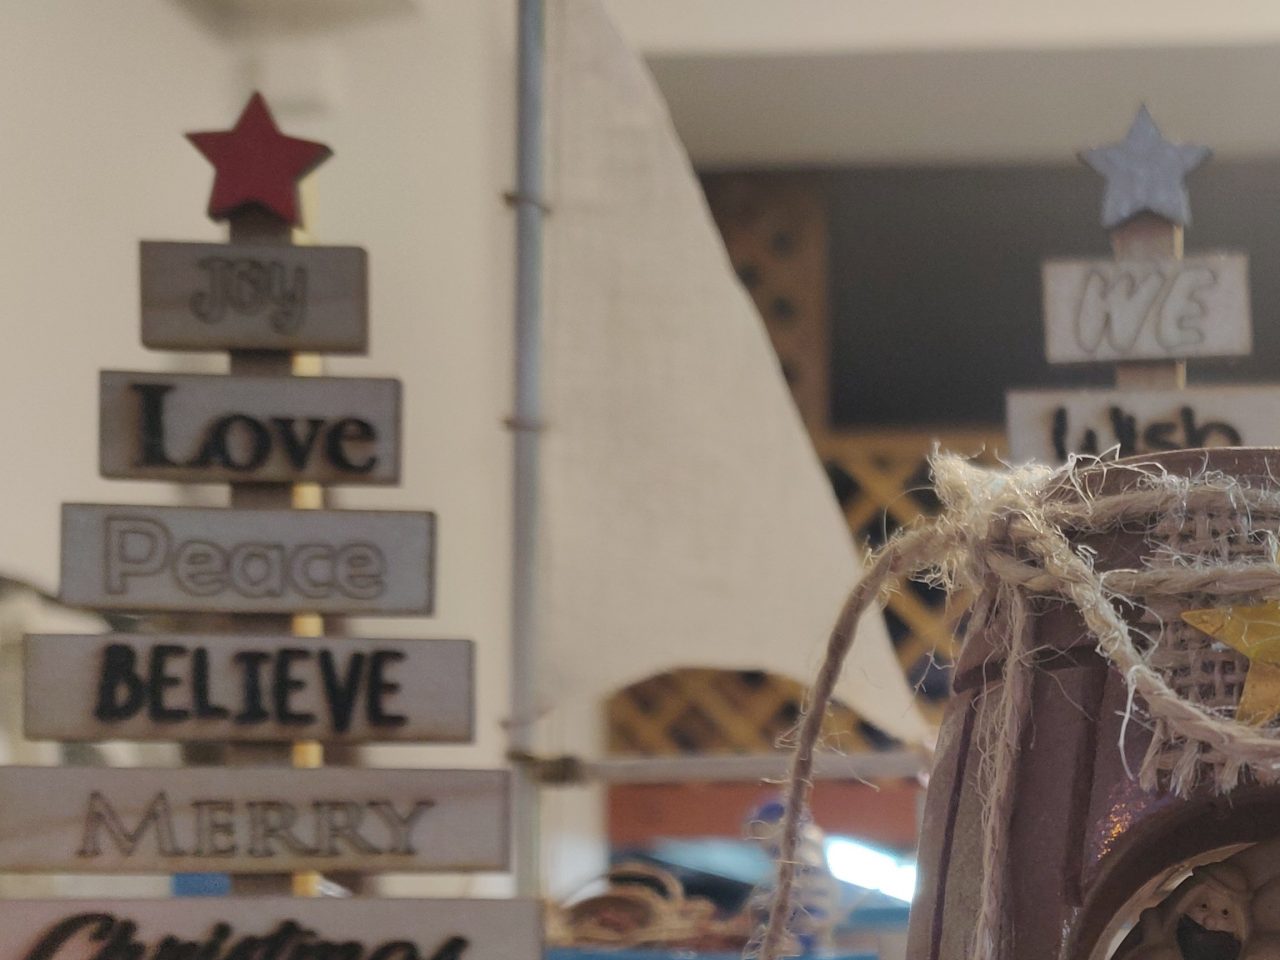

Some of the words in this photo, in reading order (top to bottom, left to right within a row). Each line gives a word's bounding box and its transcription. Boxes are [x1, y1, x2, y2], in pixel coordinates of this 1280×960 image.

[128, 383, 377, 472] Love
[104, 516, 385, 597] Peace
[95, 643, 407, 732] BELIEVE
[75, 790, 435, 858] MERRY
